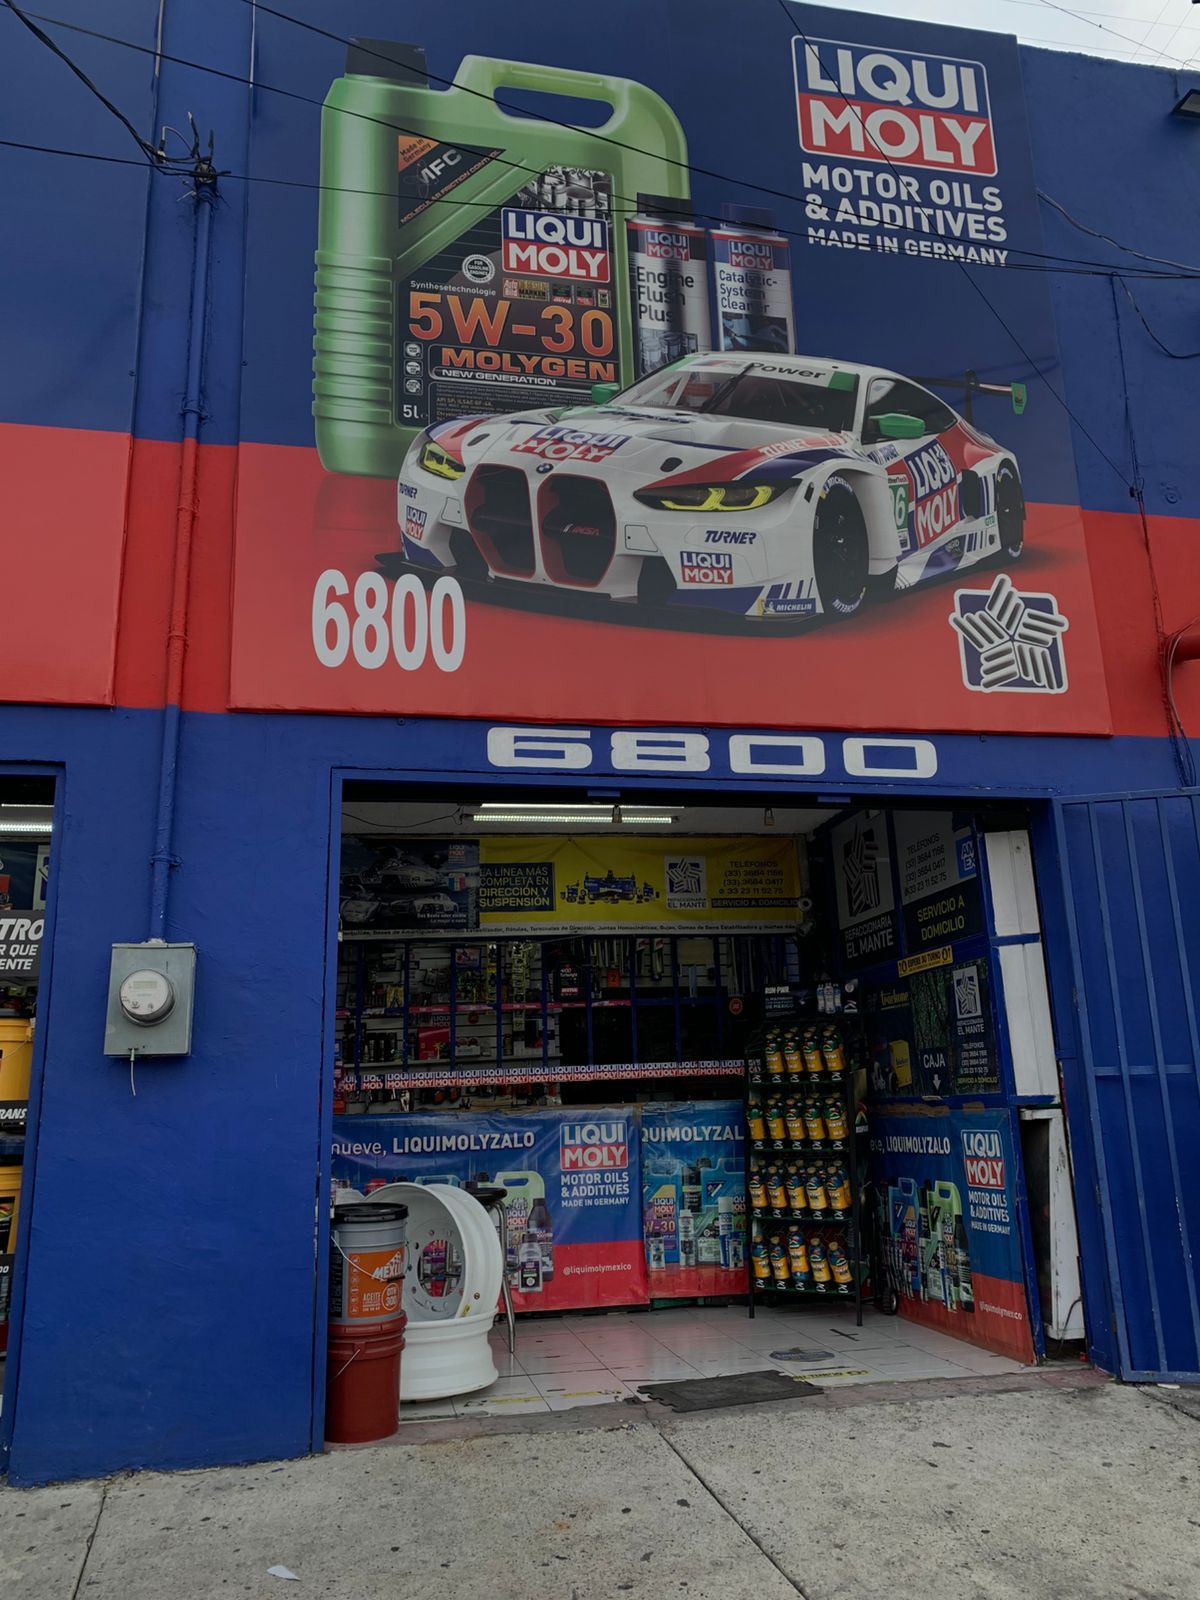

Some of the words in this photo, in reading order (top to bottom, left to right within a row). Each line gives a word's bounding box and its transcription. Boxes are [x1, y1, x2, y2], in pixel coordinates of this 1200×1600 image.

[805, 44, 978, 112] LIQUI
[810, 99, 986, 166] MOLY
[441, 170, 468, 194] FRICTION
[802, 162, 921, 202] MOTOR
[930, 179, 1003, 212] OILS
[805, 193, 830, 221] &
[835, 198, 1007, 242] ADDITIVES
[508, 212, 603, 248] LIQUI
[647, 231, 687, 247] LIQUI
[647, 245, 690, 261] MOLY
[730, 242, 772, 257] LIQUI
[808, 227, 871, 250] MADE
[876, 235, 898, 253] IN
[904, 239, 1008, 266] GERMANY
[509, 243, 606, 277] MOLY
[731, 255, 773, 270] MOLY
[410, 280, 496, 296] Synthesetechnologie
[408, 291, 614, 357] 5W-30
[441, 348, 615, 381] MOLYGEN
[752, 362, 826, 378] Power
[442, 368, 474, 379] NEW
[475, 371, 556, 386] GENERATION
[533, 427, 630, 449] LIQUI
[514, 439, 612, 461] MOLY
[908, 443, 956, 498] LIQUI
[917, 485, 957, 544] MOLY
[704, 530, 757, 545] TURNER
[682, 552, 732, 569] LIQUI
[683, 568, 732, 584] MOLY
[776, 602, 813, 612] MICHELIN
[311, 569, 466, 673] 6800
[486, 727, 939, 779] 6800
[480, 877, 534, 887] COMPLETA
[537, 876, 549, 885] EN
[541, 887, 548, 895] Y
[480, 896, 550, 907] SUSPENSIÓN
[917, 896, 956, 923] SERVICIO
[958, 894, 965, 910] A
[921, 914, 965, 940] DOMICILIO
[9, 944, 38, 957] QUE
[846, 941, 859, 959] EL
[860, 927, 894, 955] MANTE
[957, 1026, 966, 1036] EL
[966, 1023, 985, 1035] MANTE
[923, 1053, 946, 1069] CAJA
[387, 1081, 409, 1089] MOLY
[435, 1079, 457, 1087] MOLY
[483, 1077, 504, 1085] MOLY
[528, 1075, 549, 1083] MOLY
[574, 1073, 595, 1081] MOLY
[619, 1071, 639, 1079] MOLY
[722, 1067, 742, 1075] MOLY
[331, 1140, 387, 1157] nueve,
[392, 1131, 535, 1154] LIQUIMOLYZALO
[564, 1123, 624, 1145] LIQUI
[886, 1135, 950, 1155] LIQUIMOLYZALO
[963, 1132, 1000, 1158] LIQUI
[564, 1146, 627, 1167] MOLY
[561, 1173, 601, 1186] MOTOR
[604, 1171, 629, 1183] OILS
[966, 1160, 1004, 1186] MOLY
[561, 1187, 570, 1198] &
[572, 1184, 630, 1197] ADDITIVES
[968, 1191, 990, 1205] MOTOR
[992, 1194, 1007, 1207] OILS
[561, 1198, 583, 1207] MADE
[585, 1198, 592, 1206] IN
[594, 1196, 630, 1206] GERMANY
[654, 1205, 675, 1213] MOLY
[975, 1206, 1009, 1223] ADDITIVES
[988, 1223, 1011, 1235] GERMANY
[563, 1262, 632, 1275] @liquimolymexico
